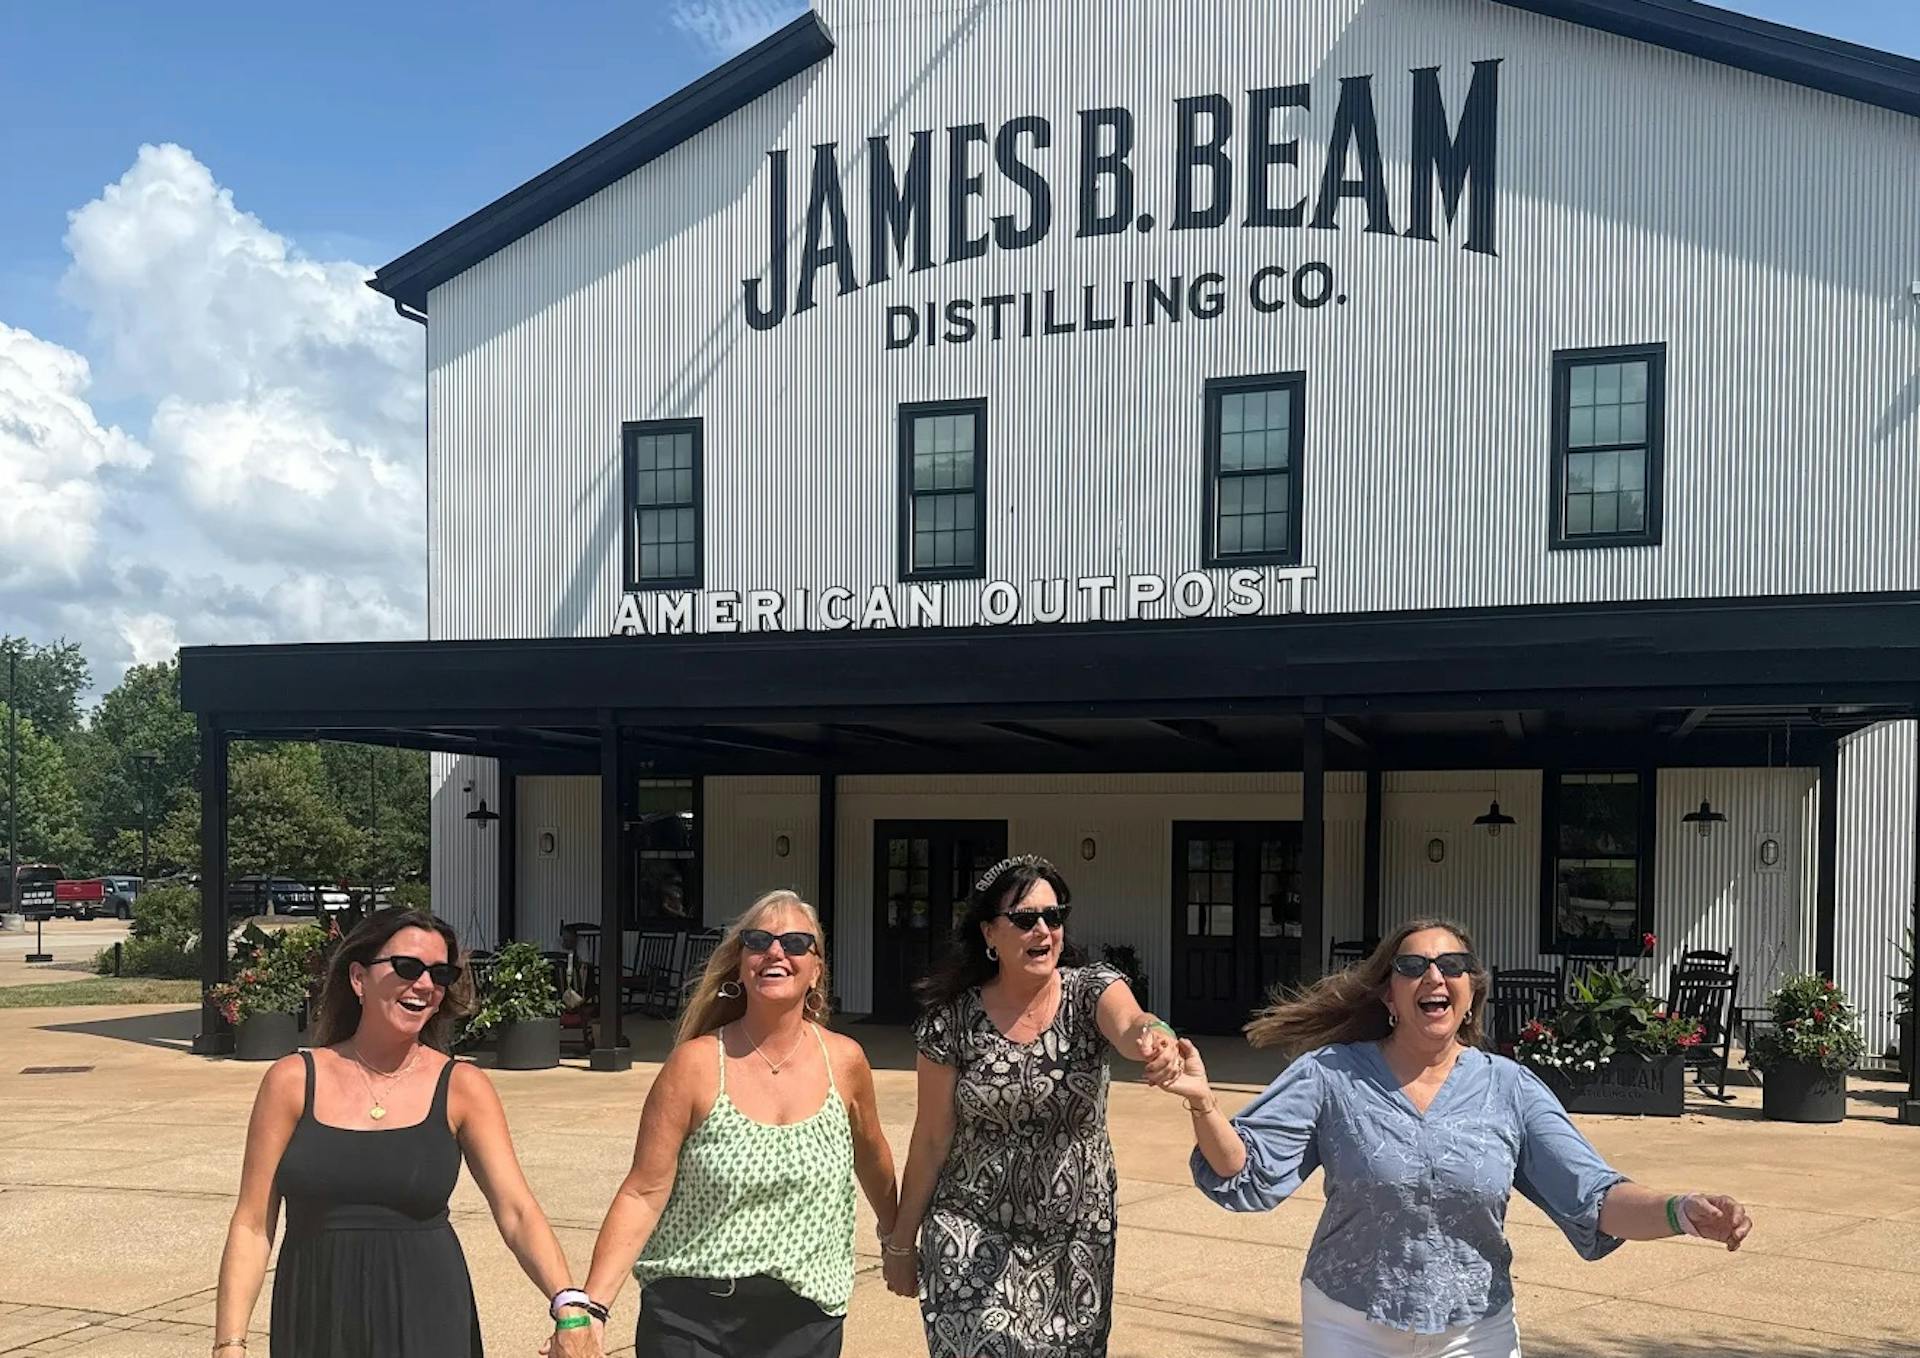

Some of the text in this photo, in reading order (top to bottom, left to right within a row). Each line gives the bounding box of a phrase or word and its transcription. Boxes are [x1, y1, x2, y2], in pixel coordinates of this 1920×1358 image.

[741, 58, 1503, 331] JAMES B. BEAM
[884, 261, 1347, 350] DISTILLING CO.
[611, 567, 1317, 636] AMERICAN OUTPOST
[976, 855, 1025, 891] BIRTHDAY
